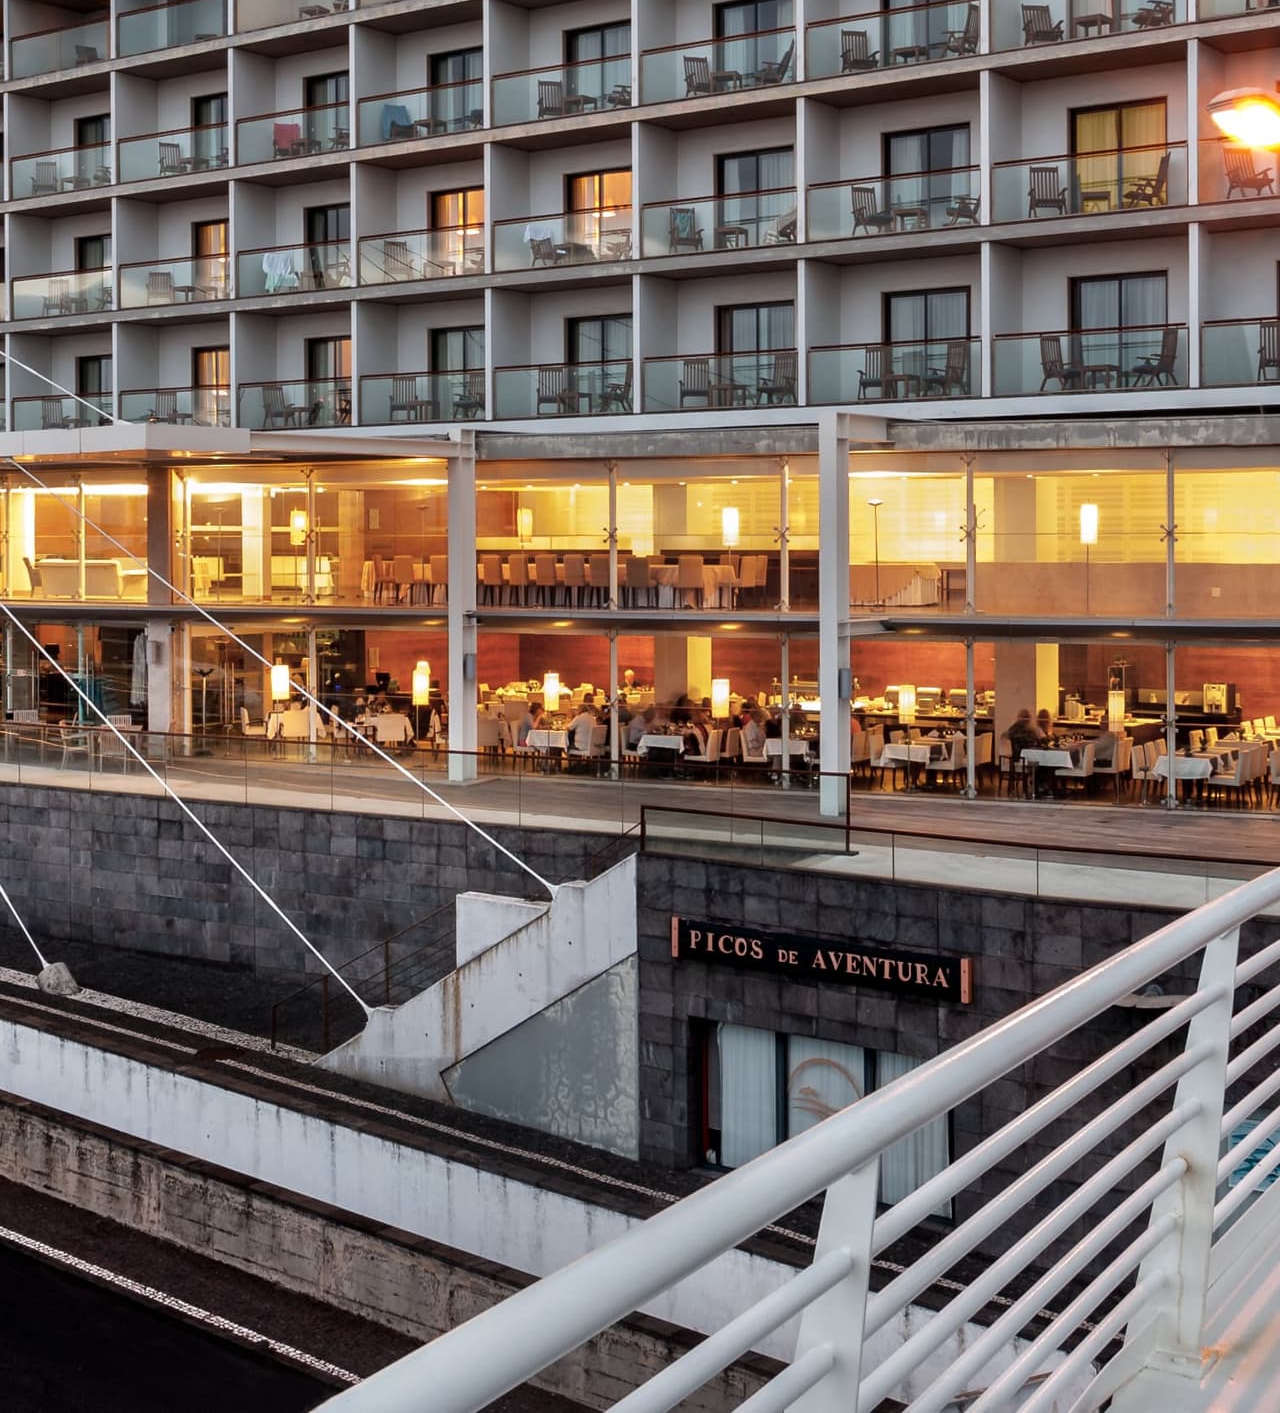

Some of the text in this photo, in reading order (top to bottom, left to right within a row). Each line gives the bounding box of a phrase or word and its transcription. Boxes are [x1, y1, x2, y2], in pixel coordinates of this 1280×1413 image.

[689, 929, 950, 988] PICOS DE AVENTURA
